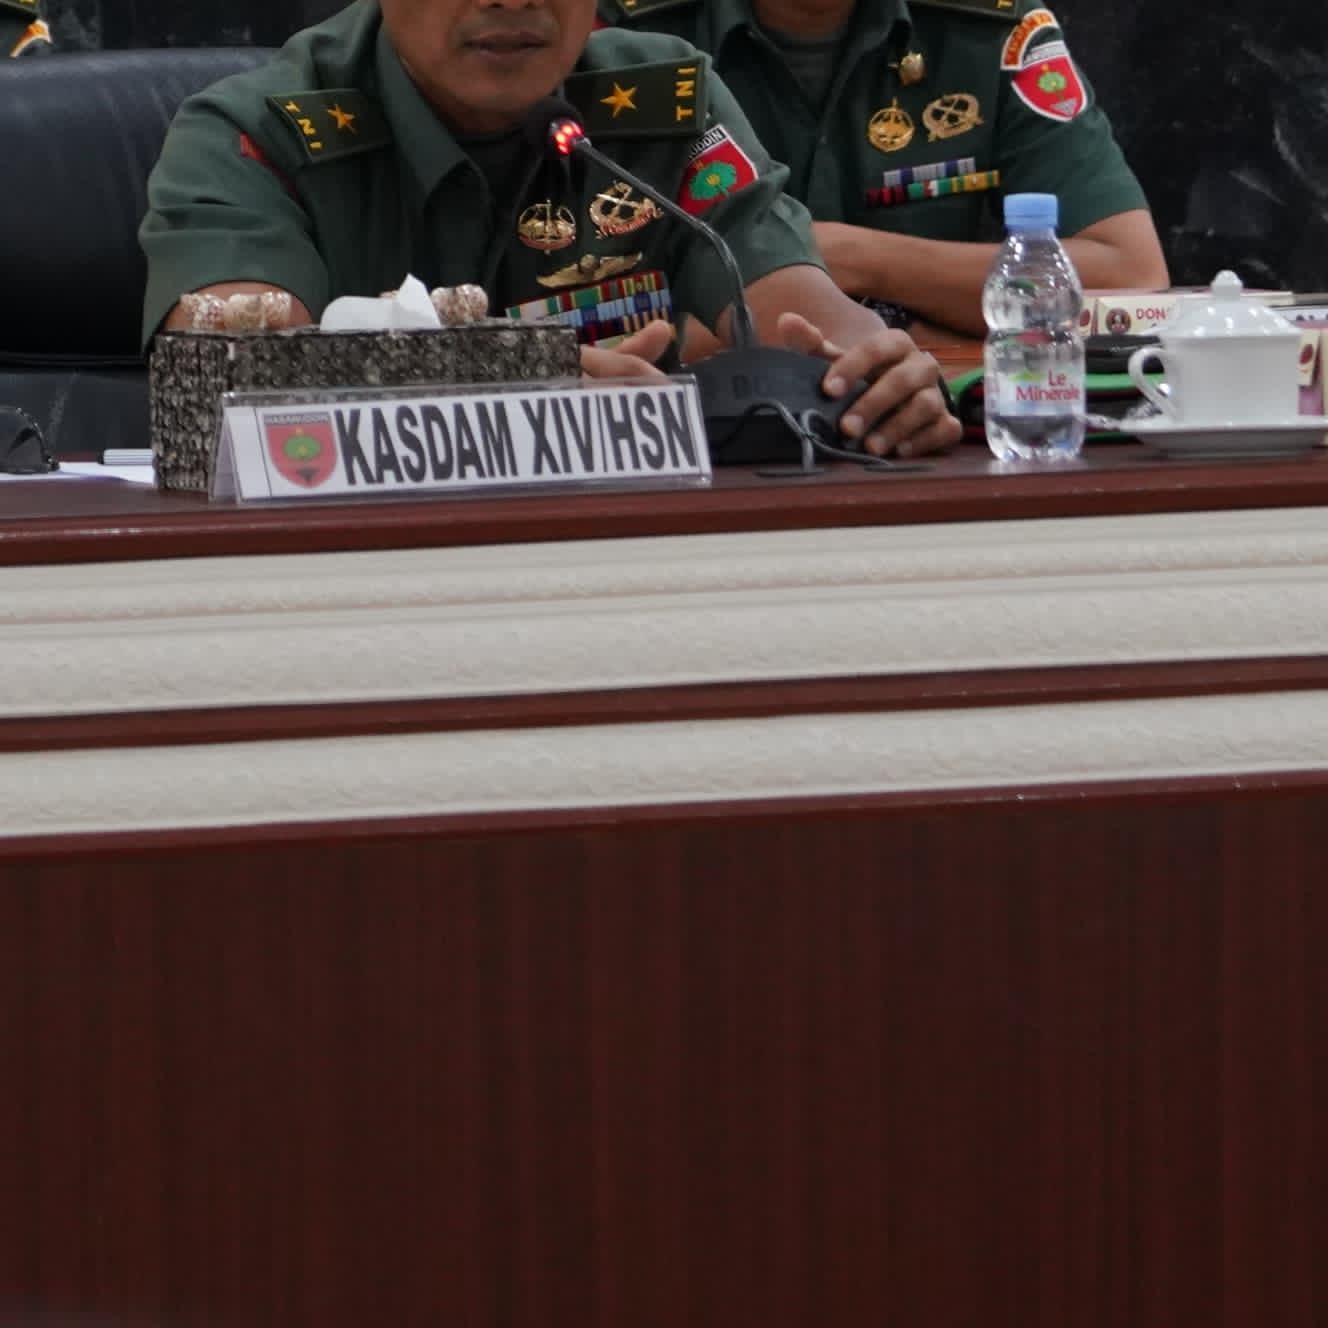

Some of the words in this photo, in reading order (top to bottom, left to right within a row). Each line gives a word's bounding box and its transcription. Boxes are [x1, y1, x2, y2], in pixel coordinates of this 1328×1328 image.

[675, 67, 696, 121] TNI
[285, 101, 321, 149] TNI
[1136, 307, 1169, 321] DON
[1016, 383, 1081, 401] Minerale
[1048, 368, 1067, 386] Le
[333, 400, 519, 486] KASDAM
[520, 390, 698, 475] XIV/HSN
